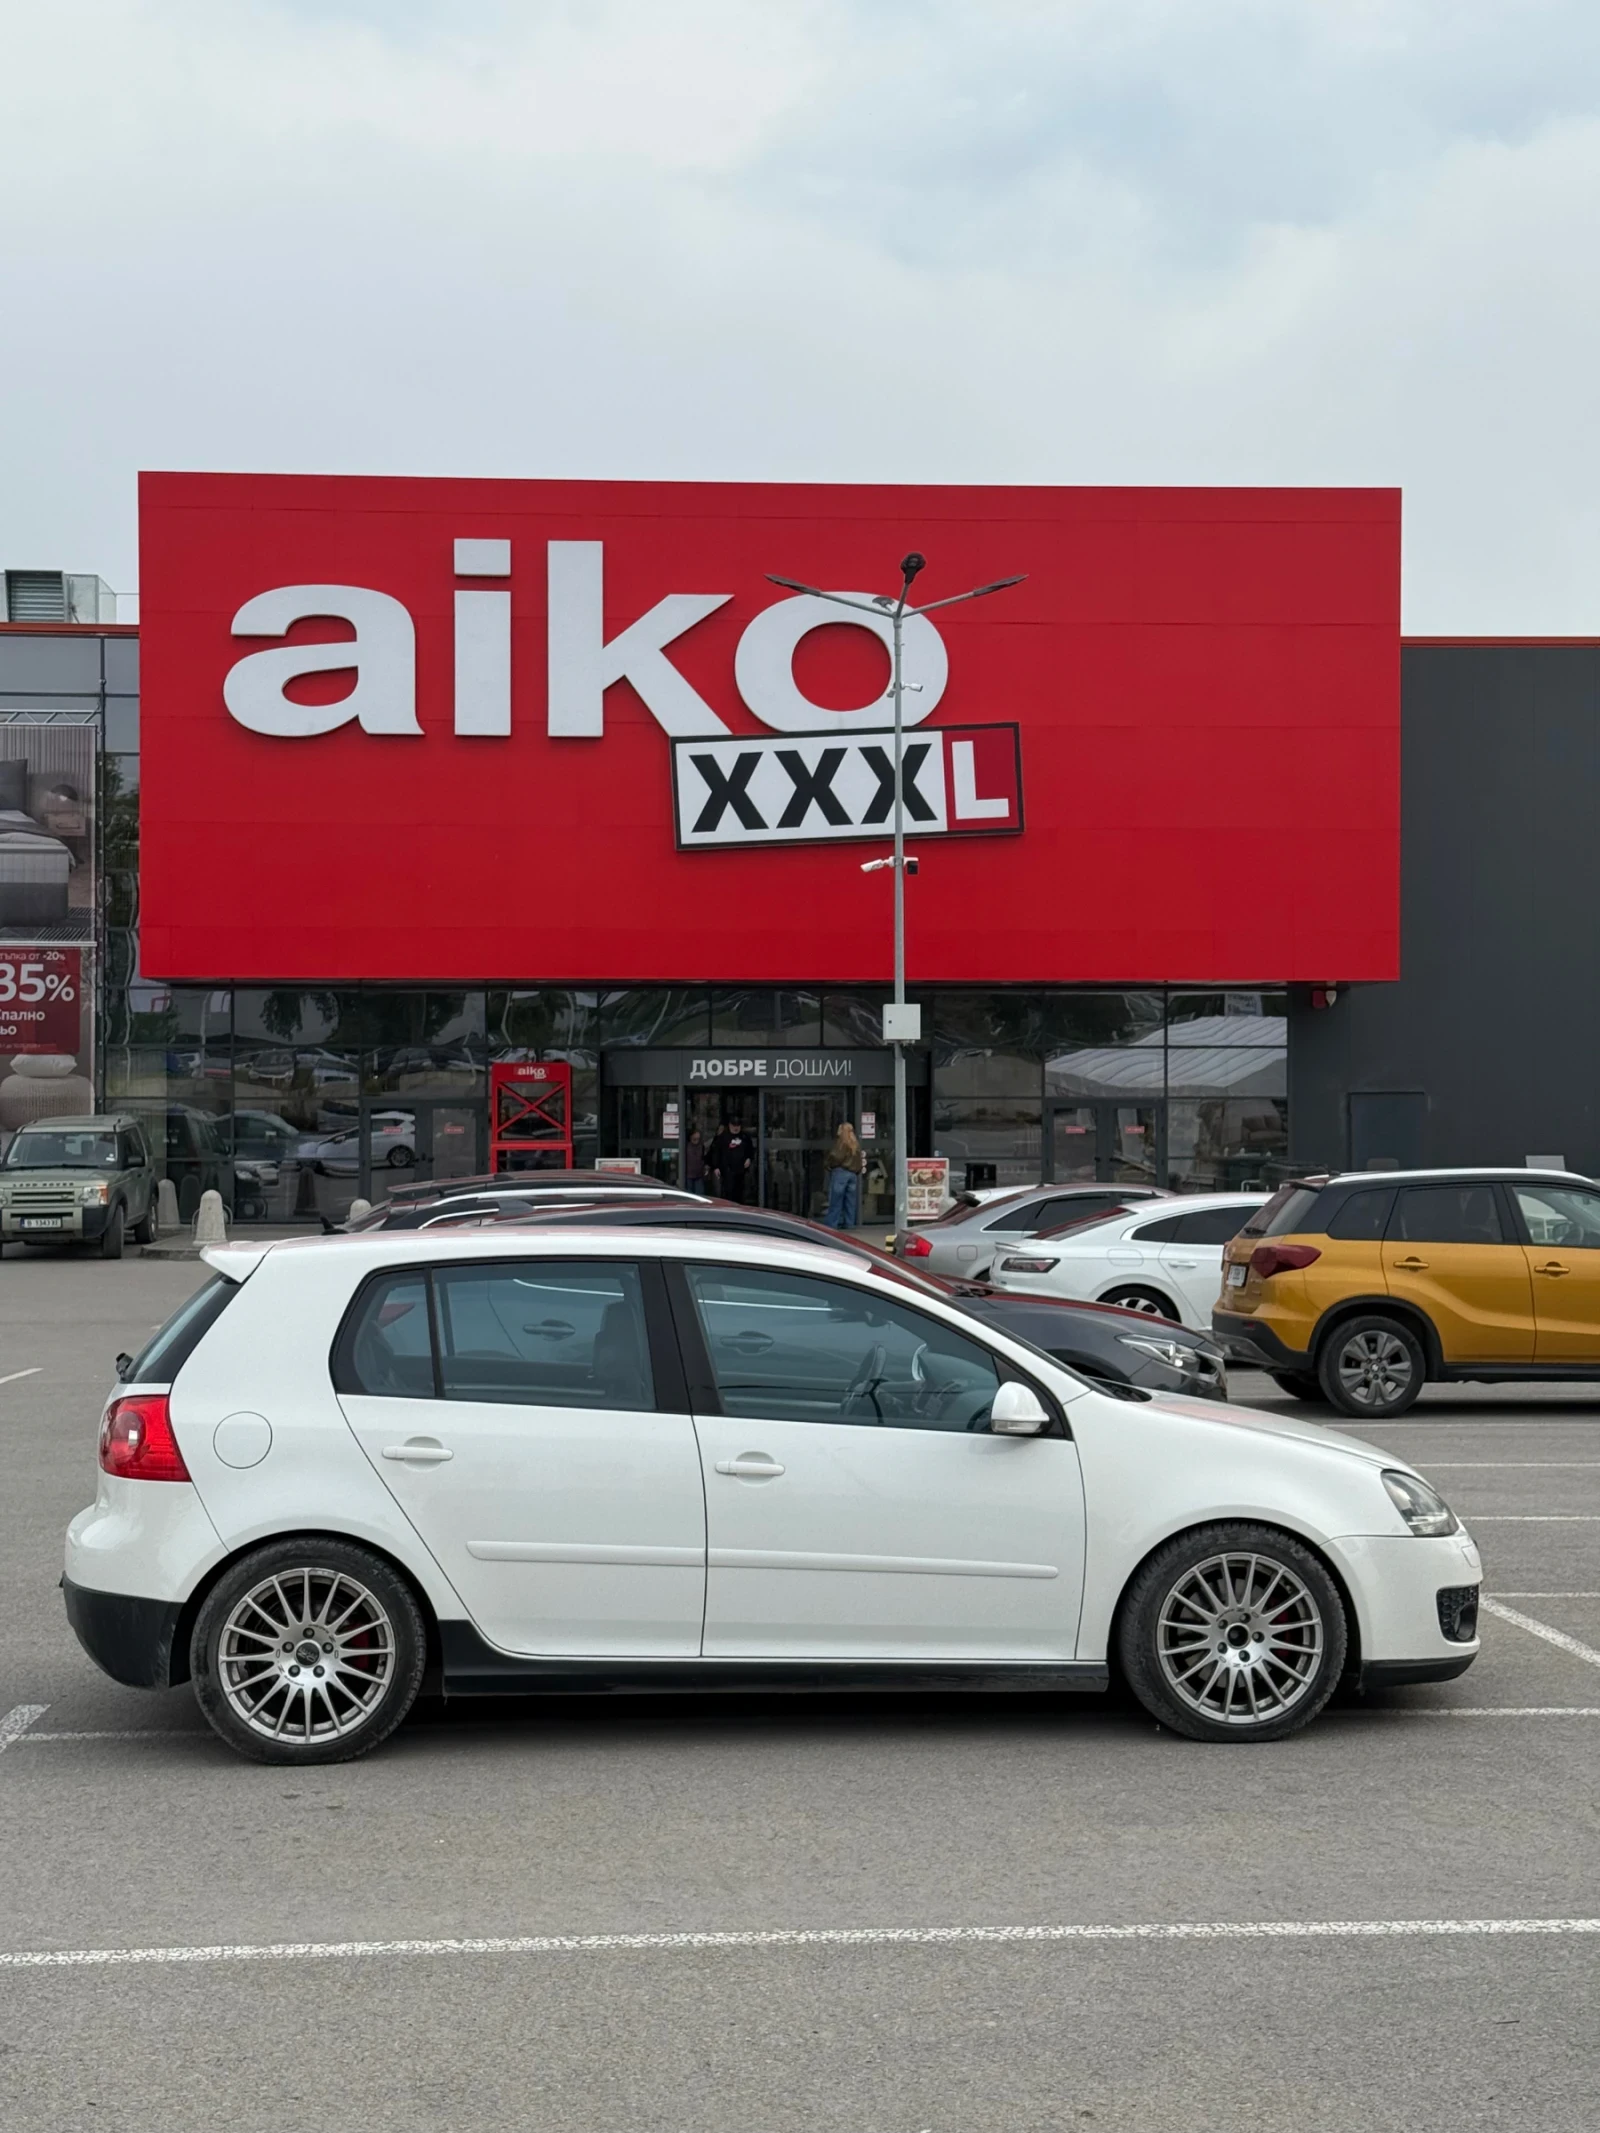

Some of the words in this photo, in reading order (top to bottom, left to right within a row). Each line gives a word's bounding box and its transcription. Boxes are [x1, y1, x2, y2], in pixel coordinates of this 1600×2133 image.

[223, 538, 949, 737] aiko
[689, 740, 1010, 833] XXXL
[43, 951, 66, 961] -20%
[517, 1066, 545, 1075] aiko
[690, 1059, 767, 1079] ДОБРЕ
[773, 1059, 852, 1079] ДОШЛИ!
